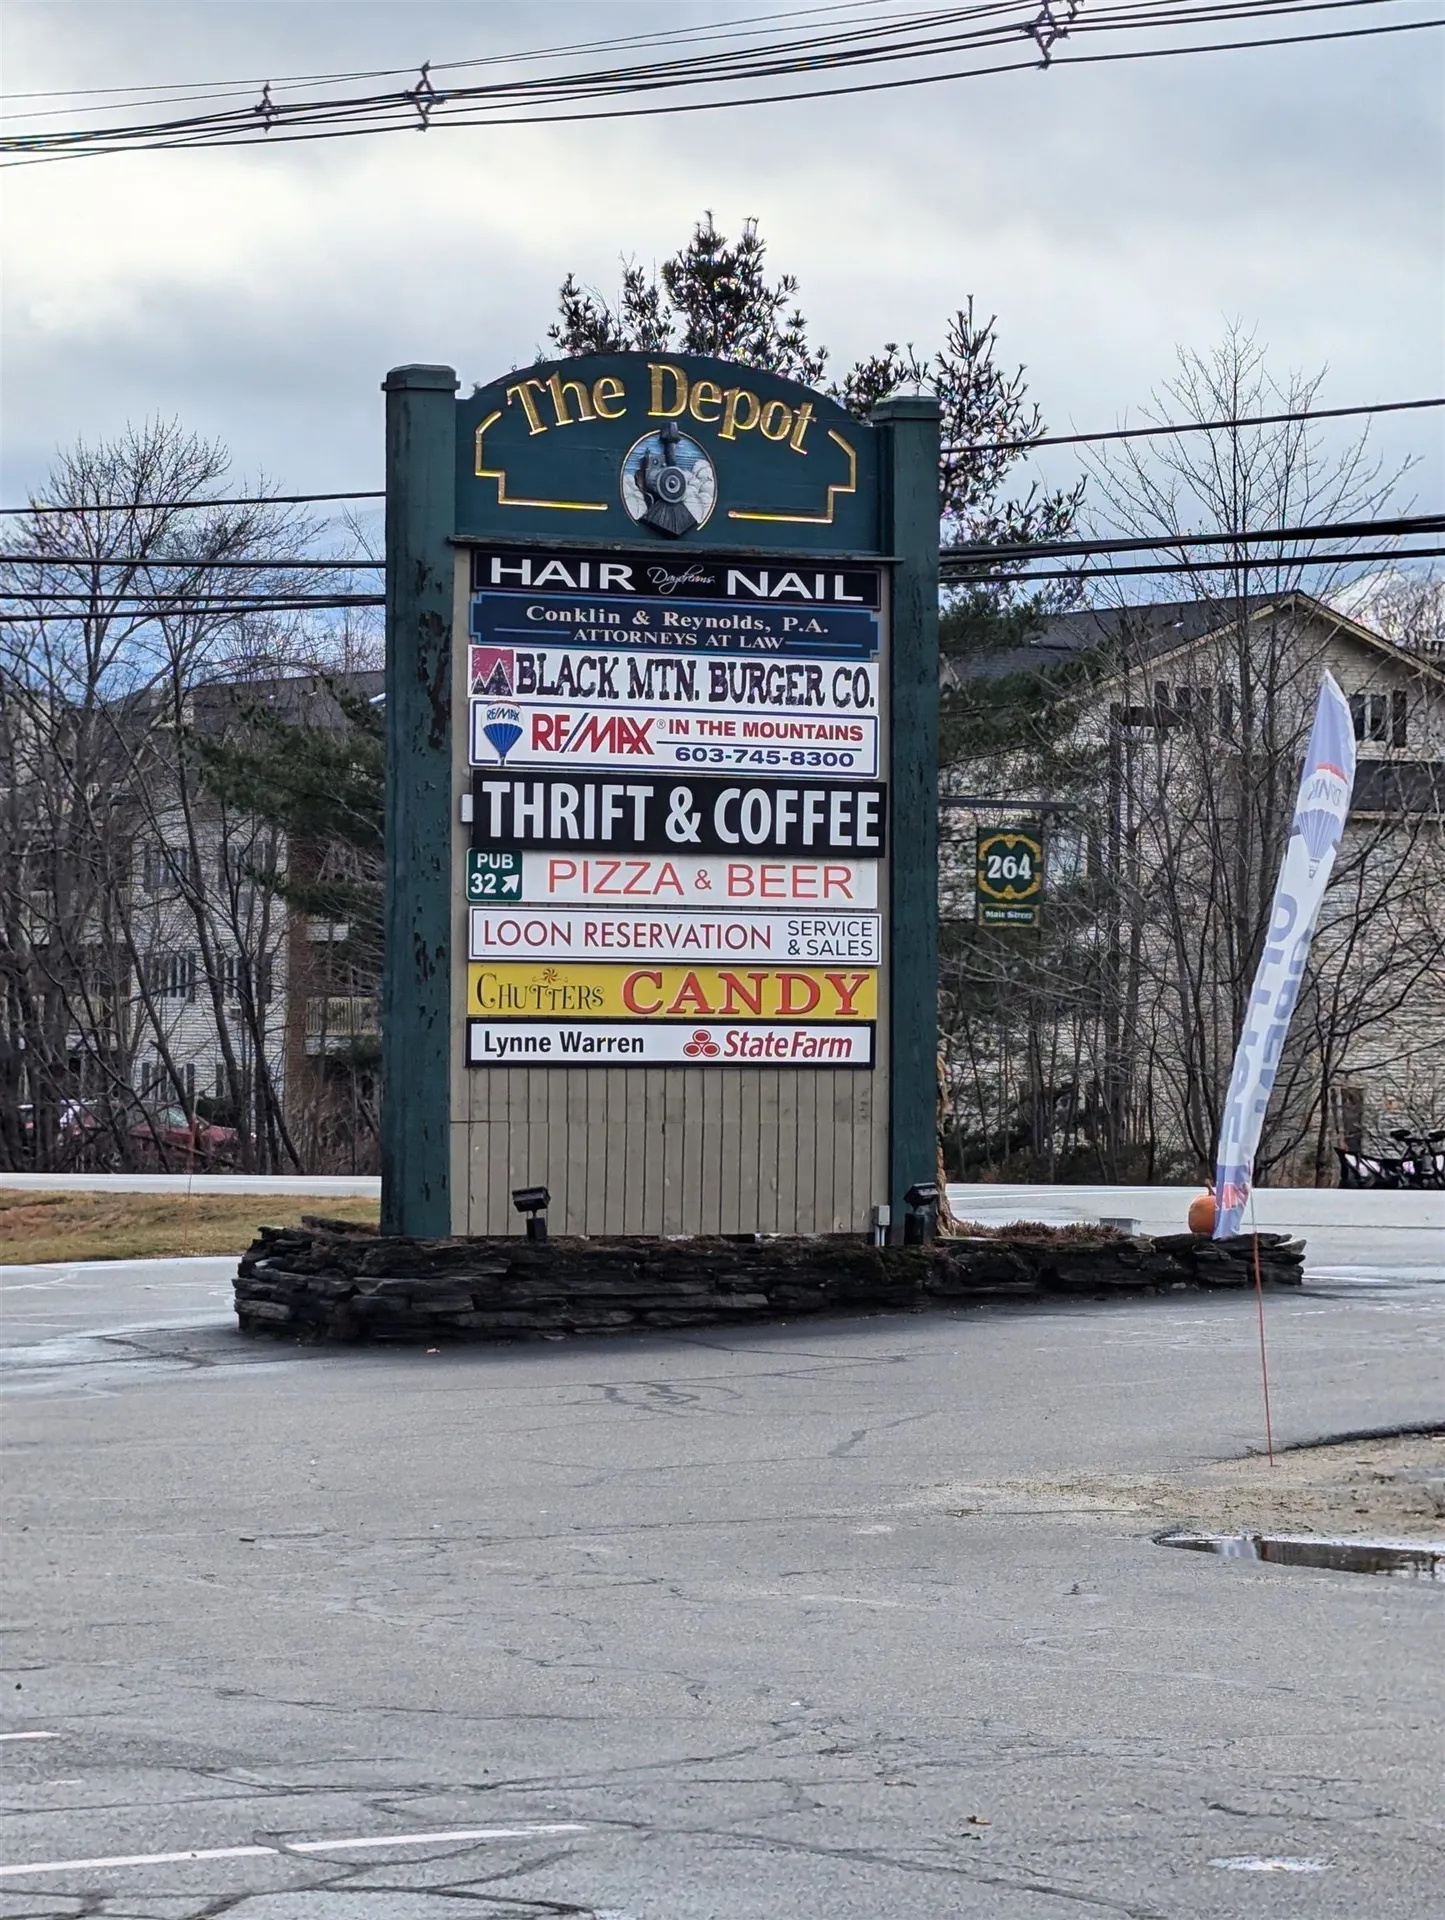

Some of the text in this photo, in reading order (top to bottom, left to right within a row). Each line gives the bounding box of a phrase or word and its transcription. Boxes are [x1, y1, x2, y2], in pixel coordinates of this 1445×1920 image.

[506, 362, 816, 455] The Depot
[491, 557, 636, 591] HAIR
[727, 570, 863, 601] NAIL
[526, 605, 829, 634] Conklin & Reynolds, P.A.
[574, 628, 784, 649] ATTORNEYS AT LAW
[516, 653, 875, 709] BLACK MTN. BURGER CO.
[487, 707, 520, 722] RE/MAX
[668, 719, 689, 735] IN
[696, 719, 736, 737] THE
[743, 722, 864, 742] MOUNTAINS
[675, 746, 854, 768] 603-745-8300
[482, 781, 880, 847] THRIFT & COFFEE
[477, 853, 514, 869] PUB
[987, 853, 1032, 880] 264
[470, 873, 497, 894] 32
[549, 859, 853, 899] PIZZA & BEER
[484, 920, 771, 950] LOON RESERVATION
[787, 920, 872, 938] SERVICE
[787, 939, 873, 957] & SALES
[476, 972, 604, 1011] CHUTTERS
[622, 970, 870, 1015] CANDY
[485, 1030, 644, 1057] Lynne Warren
